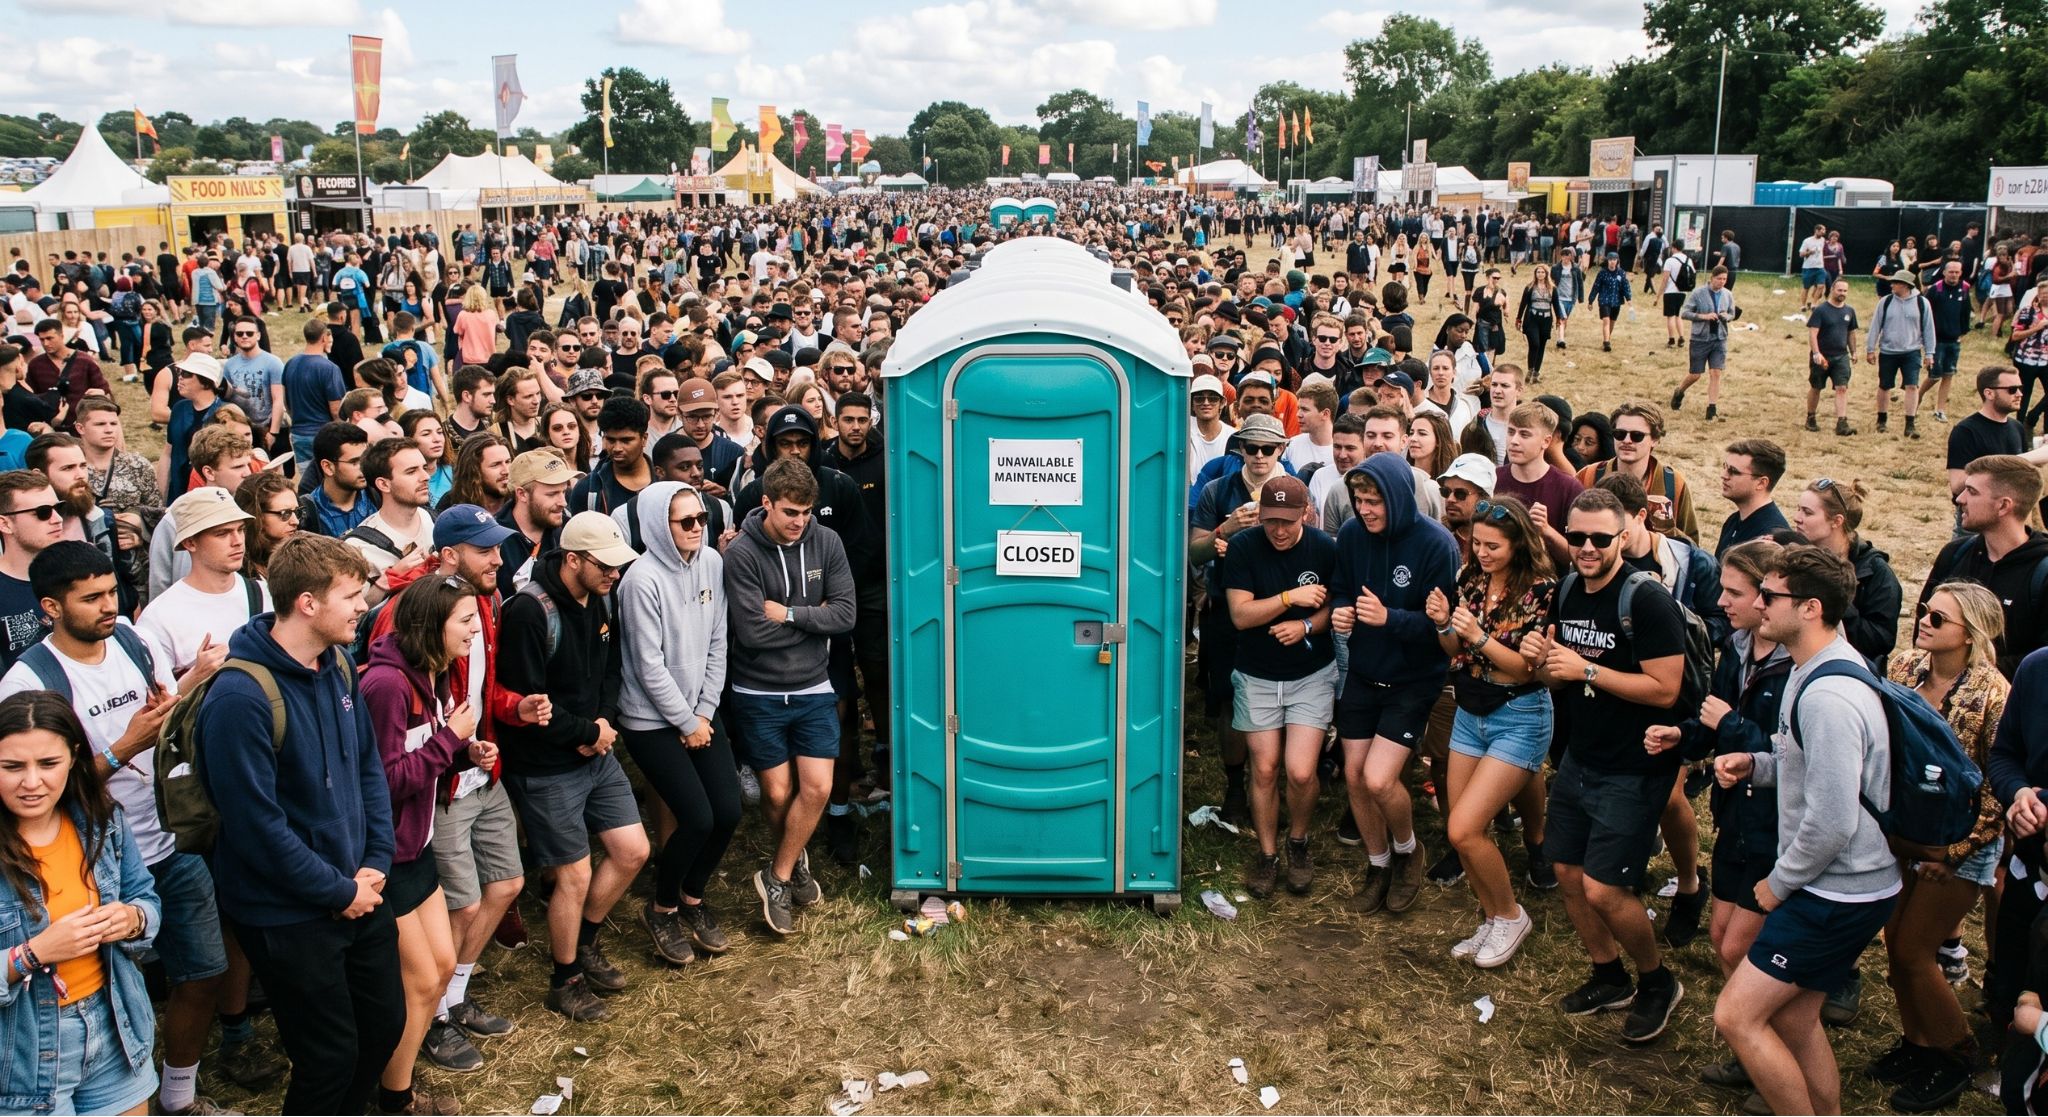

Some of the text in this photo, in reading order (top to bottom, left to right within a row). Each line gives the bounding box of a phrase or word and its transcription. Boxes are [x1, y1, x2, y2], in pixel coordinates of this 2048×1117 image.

[191, 181, 226, 198] FOOD
[997, 457, 1074, 467] UNAVAILABLE
[994, 472, 1077, 483] MAINTENANCE
[1003, 545, 1075, 563] CLOSED
